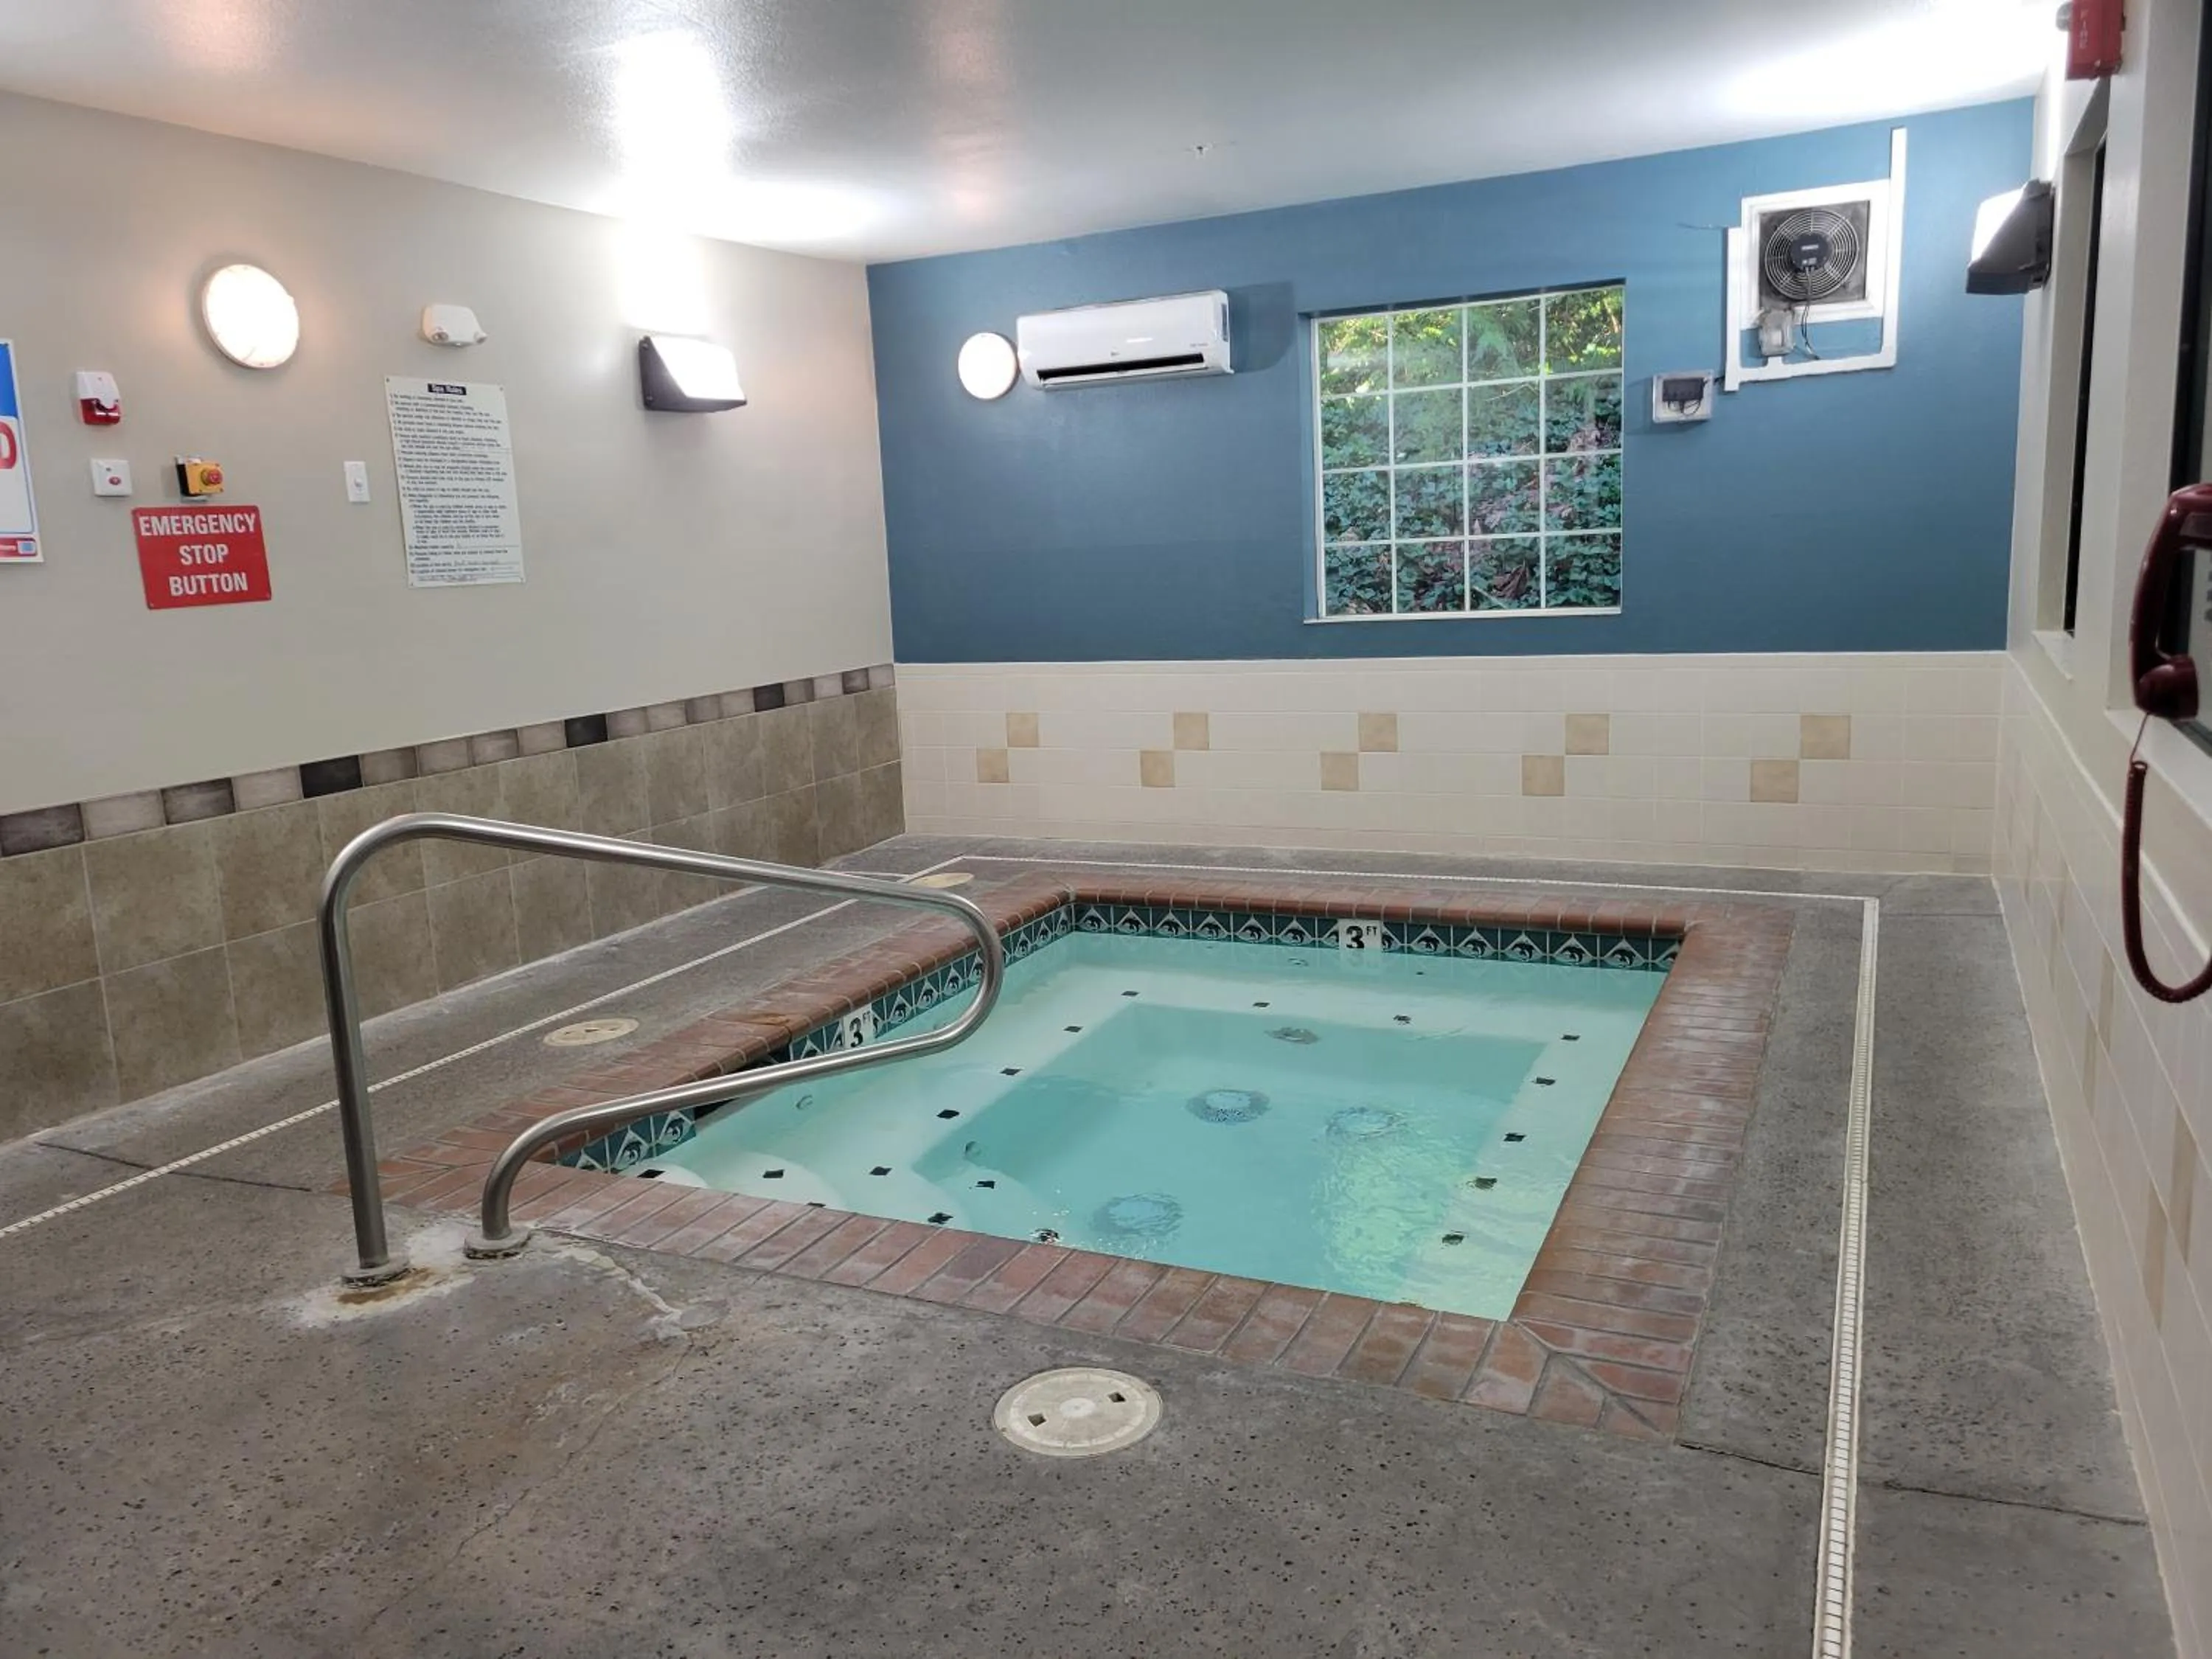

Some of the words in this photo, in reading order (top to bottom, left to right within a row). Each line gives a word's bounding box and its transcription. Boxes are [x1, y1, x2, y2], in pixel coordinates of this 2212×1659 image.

[139, 513, 256, 536] EMERGENCY
[179, 544, 229, 566] STOP
[169, 572, 248, 597] BUTTON
[1346, 925, 1365, 949] 3
[849, 1017, 863, 1048] 3
